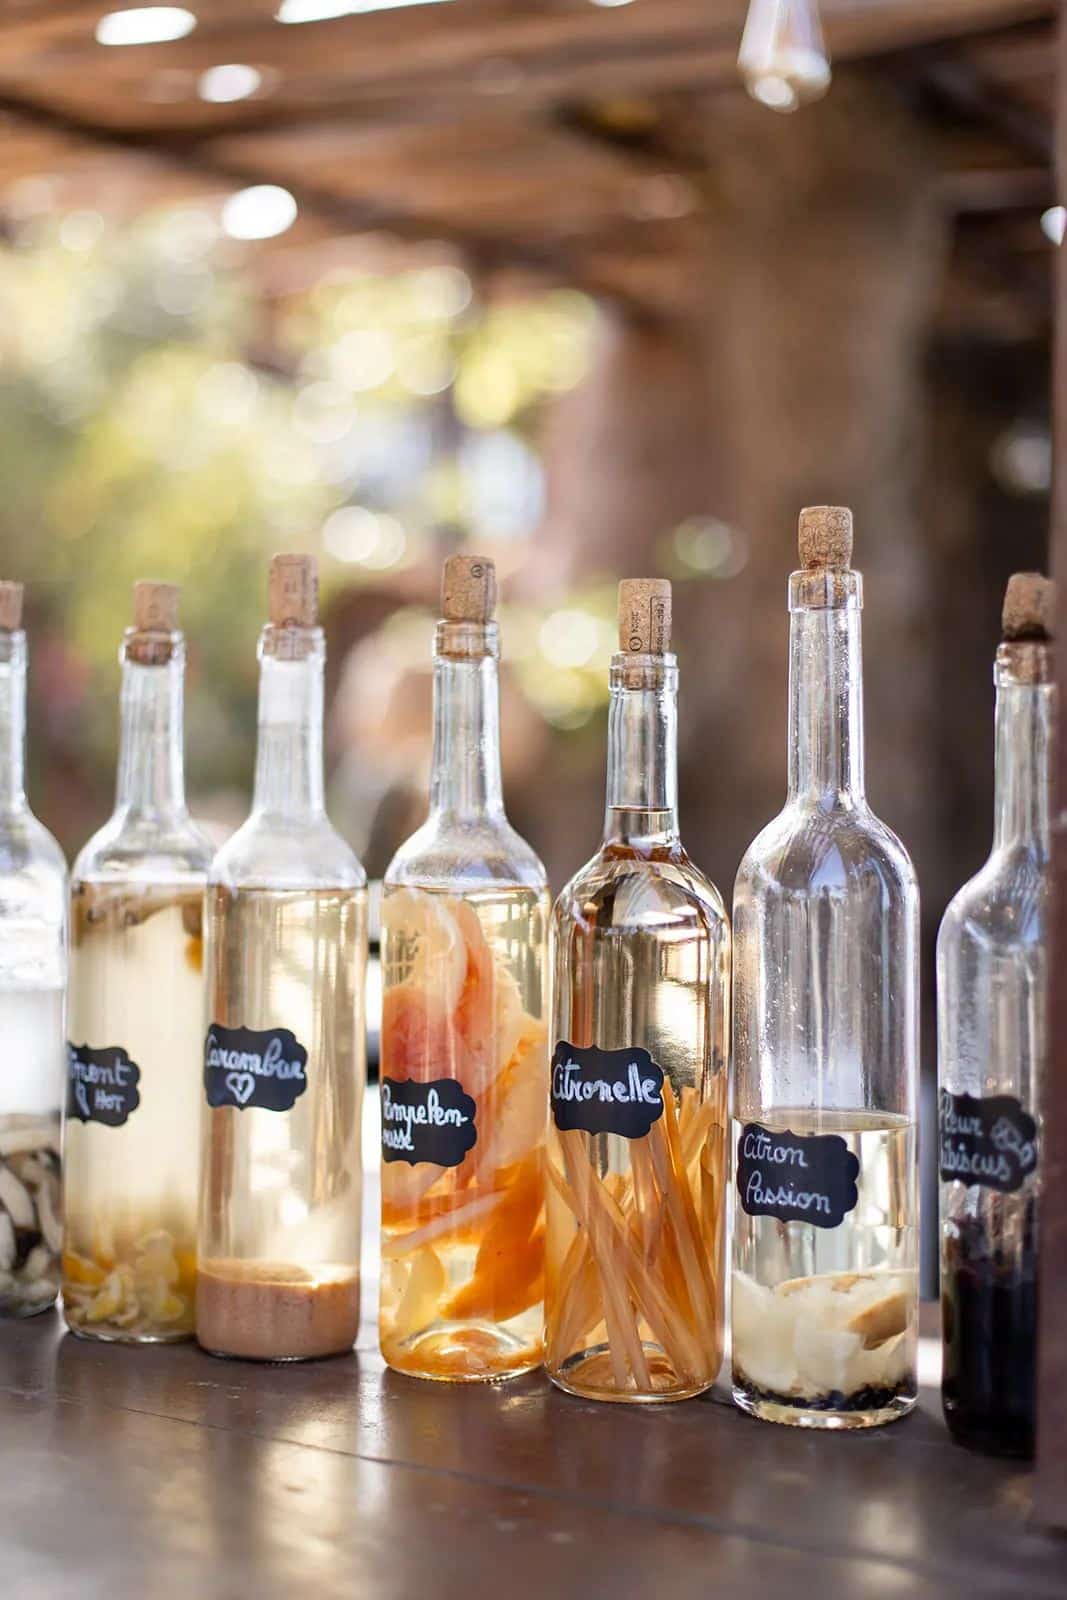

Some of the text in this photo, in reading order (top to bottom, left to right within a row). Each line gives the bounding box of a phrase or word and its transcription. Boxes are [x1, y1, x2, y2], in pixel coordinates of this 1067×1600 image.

[71, 1051, 131, 1087] iment
[206, 1034, 304, 1080] Carambar
[553, 1058, 661, 1104] Citronelle
[744, 1132, 808, 1168] Citron
[942, 1139, 1012, 1182] ibiscus
[746, 1170, 831, 1214] Passion
